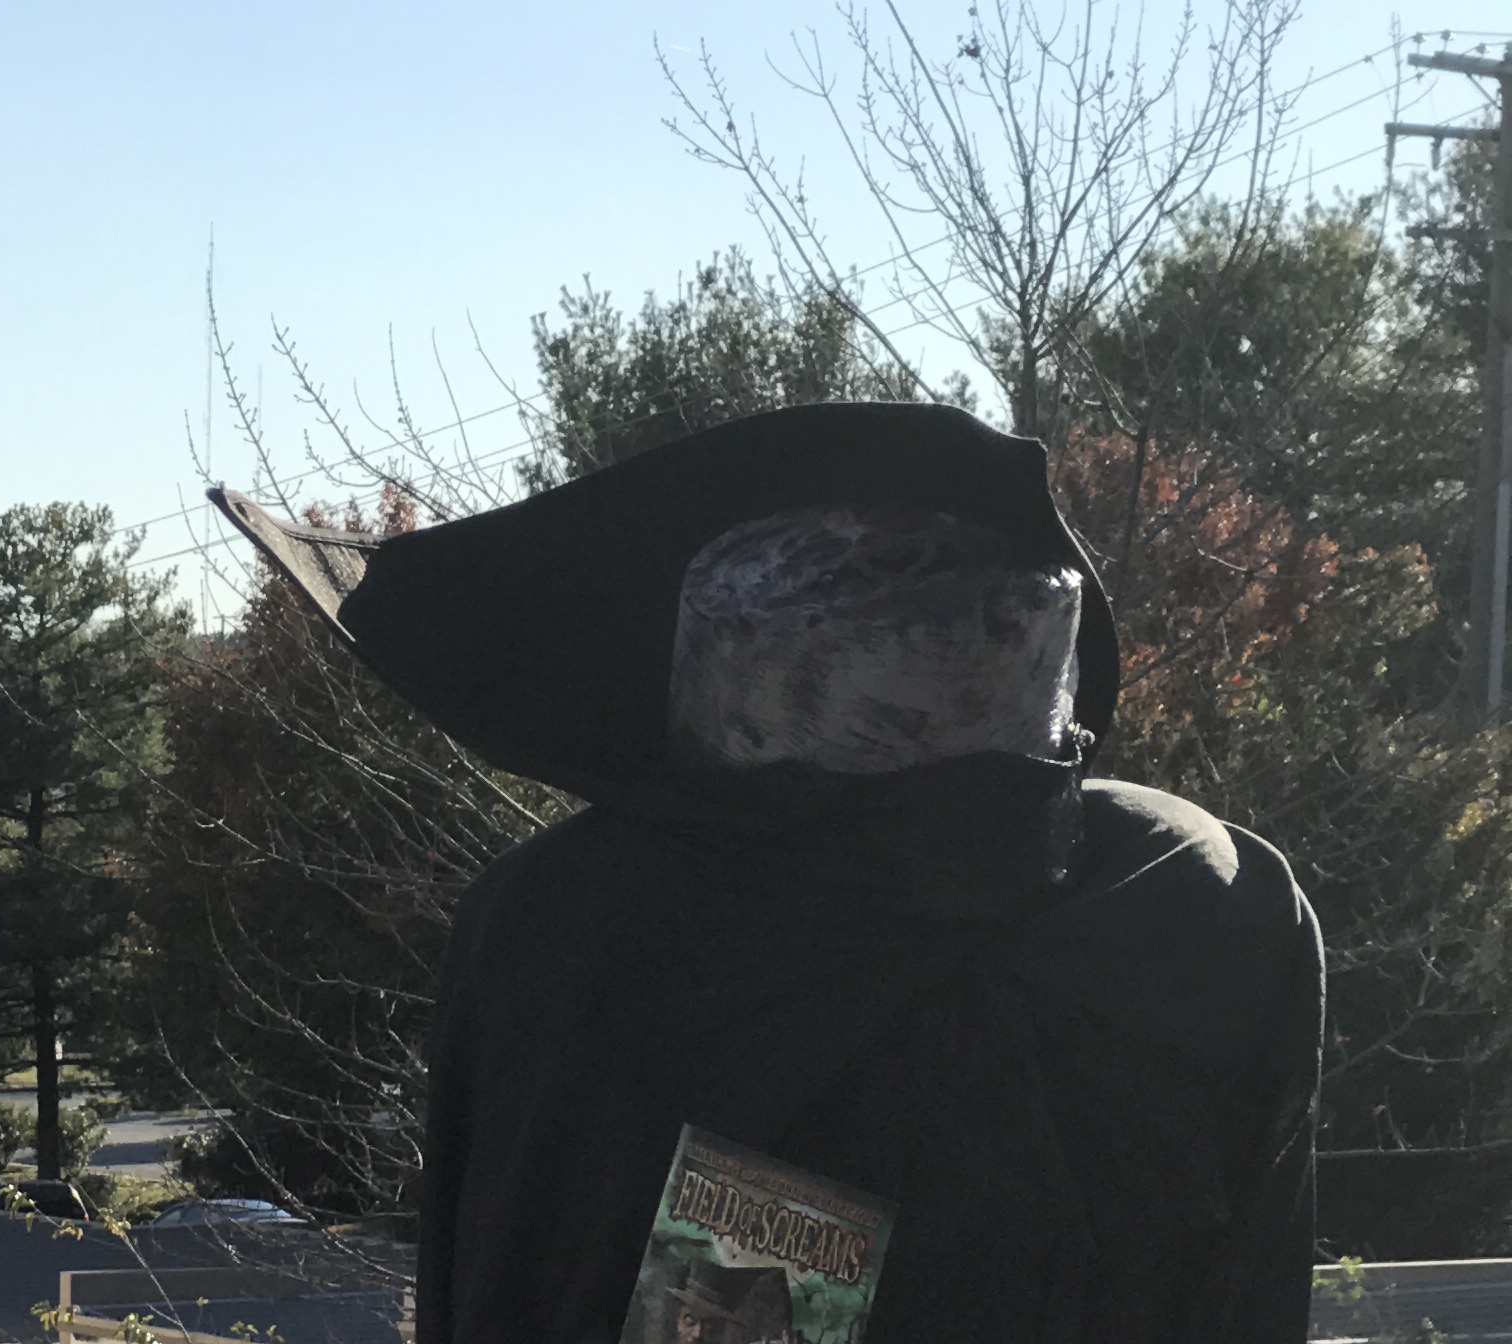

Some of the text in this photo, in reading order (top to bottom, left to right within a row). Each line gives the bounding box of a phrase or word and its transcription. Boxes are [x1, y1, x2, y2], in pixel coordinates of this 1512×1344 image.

[672, 1170, 741, 1235] FIELD
[740, 1204, 762, 1232] OF
[757, 1204, 868, 1284] SCREAMS
